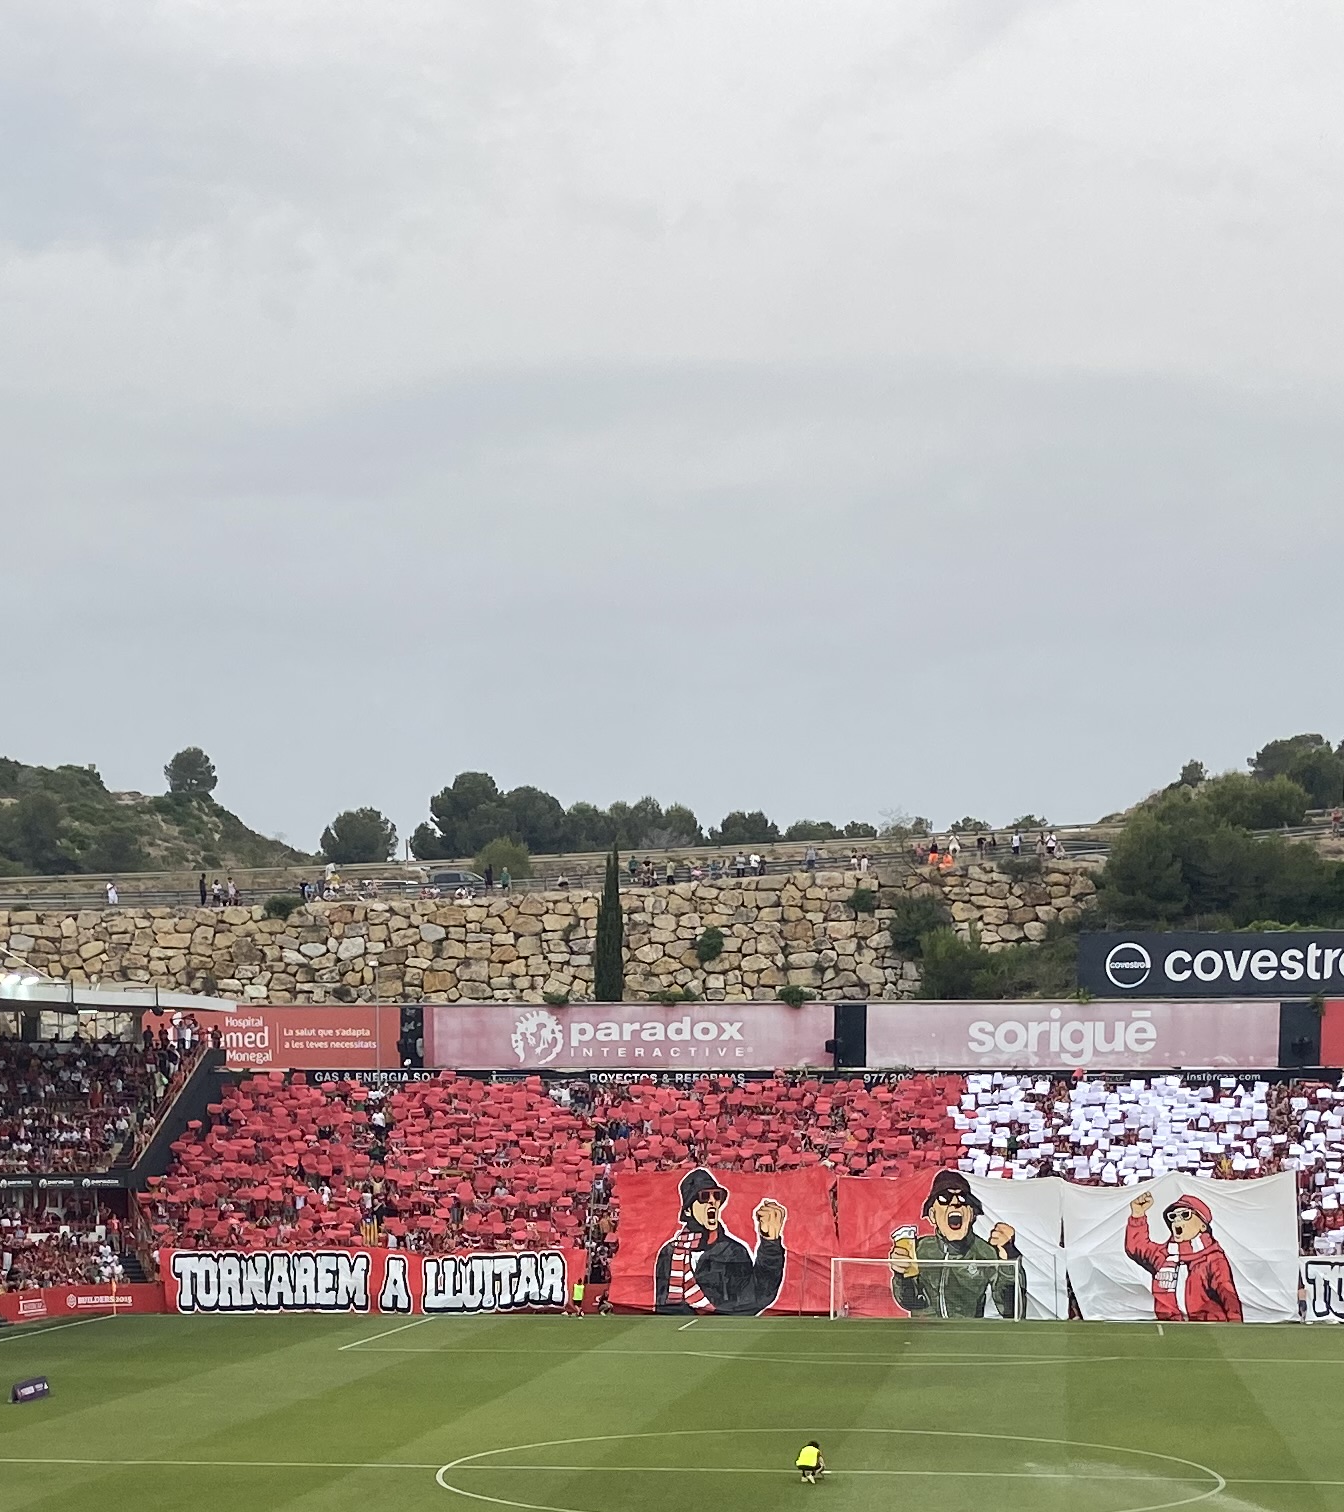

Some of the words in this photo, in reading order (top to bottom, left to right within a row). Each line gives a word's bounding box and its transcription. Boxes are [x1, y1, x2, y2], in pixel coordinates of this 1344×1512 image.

[1109, 960, 1147, 970] covestro
[225, 1016, 263, 1028] Hospital
[283, 1028, 294, 1037] La
[295, 1028, 316, 1037] salut
[317, 1030, 333, 1039] que
[335, 1028, 371, 1039] s'adapta
[570, 1016, 744, 1047] paradox
[292, 1040, 304, 1049] les
[305, 1040, 327, 1049] teves
[329, 1040, 377, 1049] necessitats
[226, 1051, 272, 1064] Monegal
[570, 1047, 745, 1058] INTERACTIVE
[314, 1071, 341, 1082] GAS
[343, 1071, 353, 1082] &
[355, 1072, 409, 1082] ENERGIA
[662, 1073, 670, 1083] &
[172, 1251, 371, 1314] TORNAREM
[378, 1256, 413, 1314] A
[422, 1252, 569, 1314] LLUITAR
